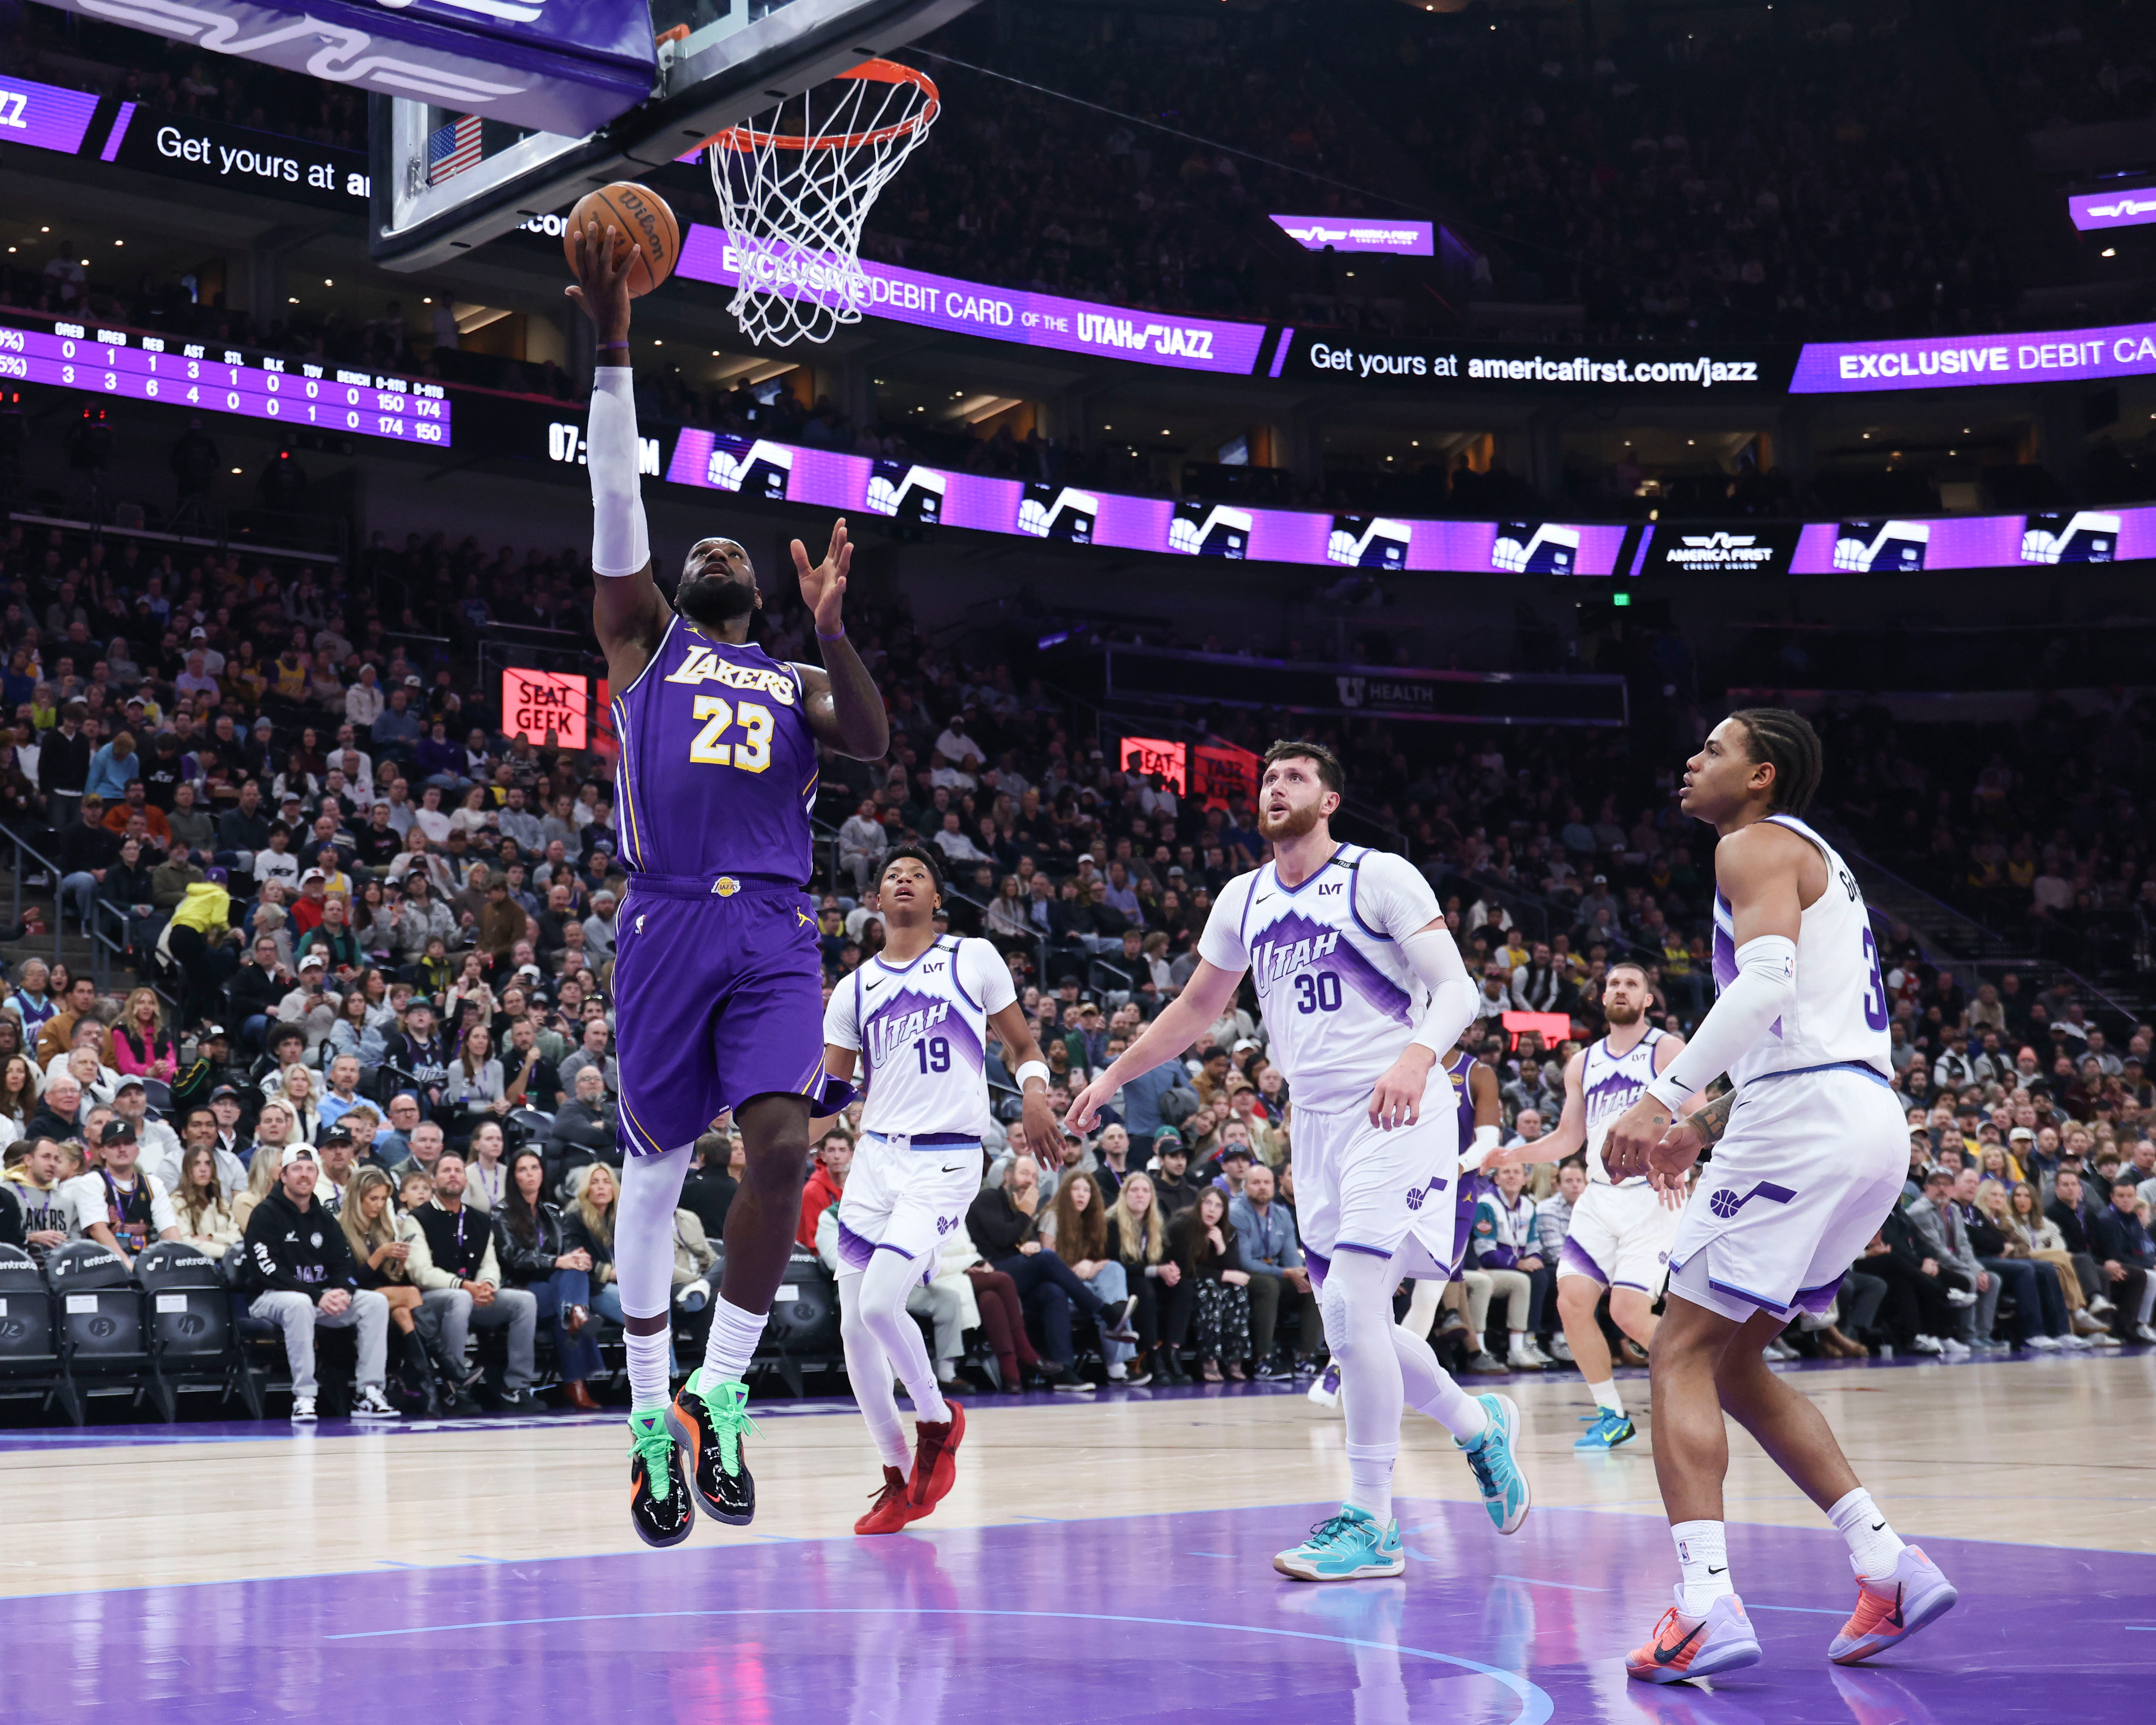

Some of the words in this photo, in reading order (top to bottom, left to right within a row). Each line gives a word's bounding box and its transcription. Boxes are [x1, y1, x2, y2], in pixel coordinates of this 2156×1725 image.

[158, 127, 211, 164] Get
[220, 147, 299, 182] yours
[308, 164, 334, 189] at
[618, 190, 664, 263] Wilson
[723, 246, 865, 298] EXCLUSIVE
[870, 277, 940, 312] DEBIT
[946, 292, 1013, 326] CARD
[1022, 312, 1040, 326] OF
[1043, 315, 1068, 332] THE
[1077, 312, 1133, 348] UTAH
[1155, 327, 1213, 359] JAZZ
[63, 341, 75, 358] 0
[107, 348, 114, 365] 1
[149, 355, 156, 372] 1
[188, 361, 199, 378] 3
[230, 369, 237, 385] 1
[267, 375, 279, 391] 0
[306, 381, 318, 398] 0
[347, 388, 359, 405] 0
[377, 394, 405, 412] 150
[415, 400, 441, 418] 174
[98, 329, 126, 345] DREB
[143, 337, 164, 352] REB
[184, 344, 205, 359] AST
[225, 351, 244, 365] STL
[264, 358, 284, 372] BLK
[303, 364, 323, 378] TOV
[337, 370, 370, 387] BENCH
[1311, 344, 1353, 371] Get
[1359, 355, 1426, 377] yours
[1435, 355, 1457, 376] at
[1469, 356, 1757, 387] americafirst.com/jazz
[1840, 347, 2010, 378] EXCLUSIVE
[2018, 341, 2105, 369] DEBIT
[63, 365, 74, 383] 3
[105, 373, 116, 389] 3
[146, 380, 158, 396] 6
[187, 386, 199, 403] 4
[227, 392, 239, 409] 0
[267, 398, 279, 415] 0
[308, 406, 315, 421] 1
[347, 411, 359, 428] 0
[378, 417, 403, 435] 174
[415, 423, 441, 441] 150
[1667, 547, 1729, 561] AMERICA
[1730, 549, 1772, 561] FIRST
[519, 682, 569, 707] SEAT
[664, 645, 795, 706] LAKERS
[1369, 683, 1433, 701] HEALTH
[516, 708, 572, 735] GEEK
[690, 695, 775, 774] 23
[1319, 883, 1344, 895] LVT
[924, 962, 945, 974] LVT
[1253, 929, 1342, 998] UTAH
[1294, 971, 1342, 1015] 30
[867, 1000, 952, 1069] UTAH
[914, 1037, 950, 1074] 19
[1586, 1084, 1648, 1128] UTAH
[24, 1207, 67, 1231] AKERS
[175, 1256, 215, 1267] entrata
